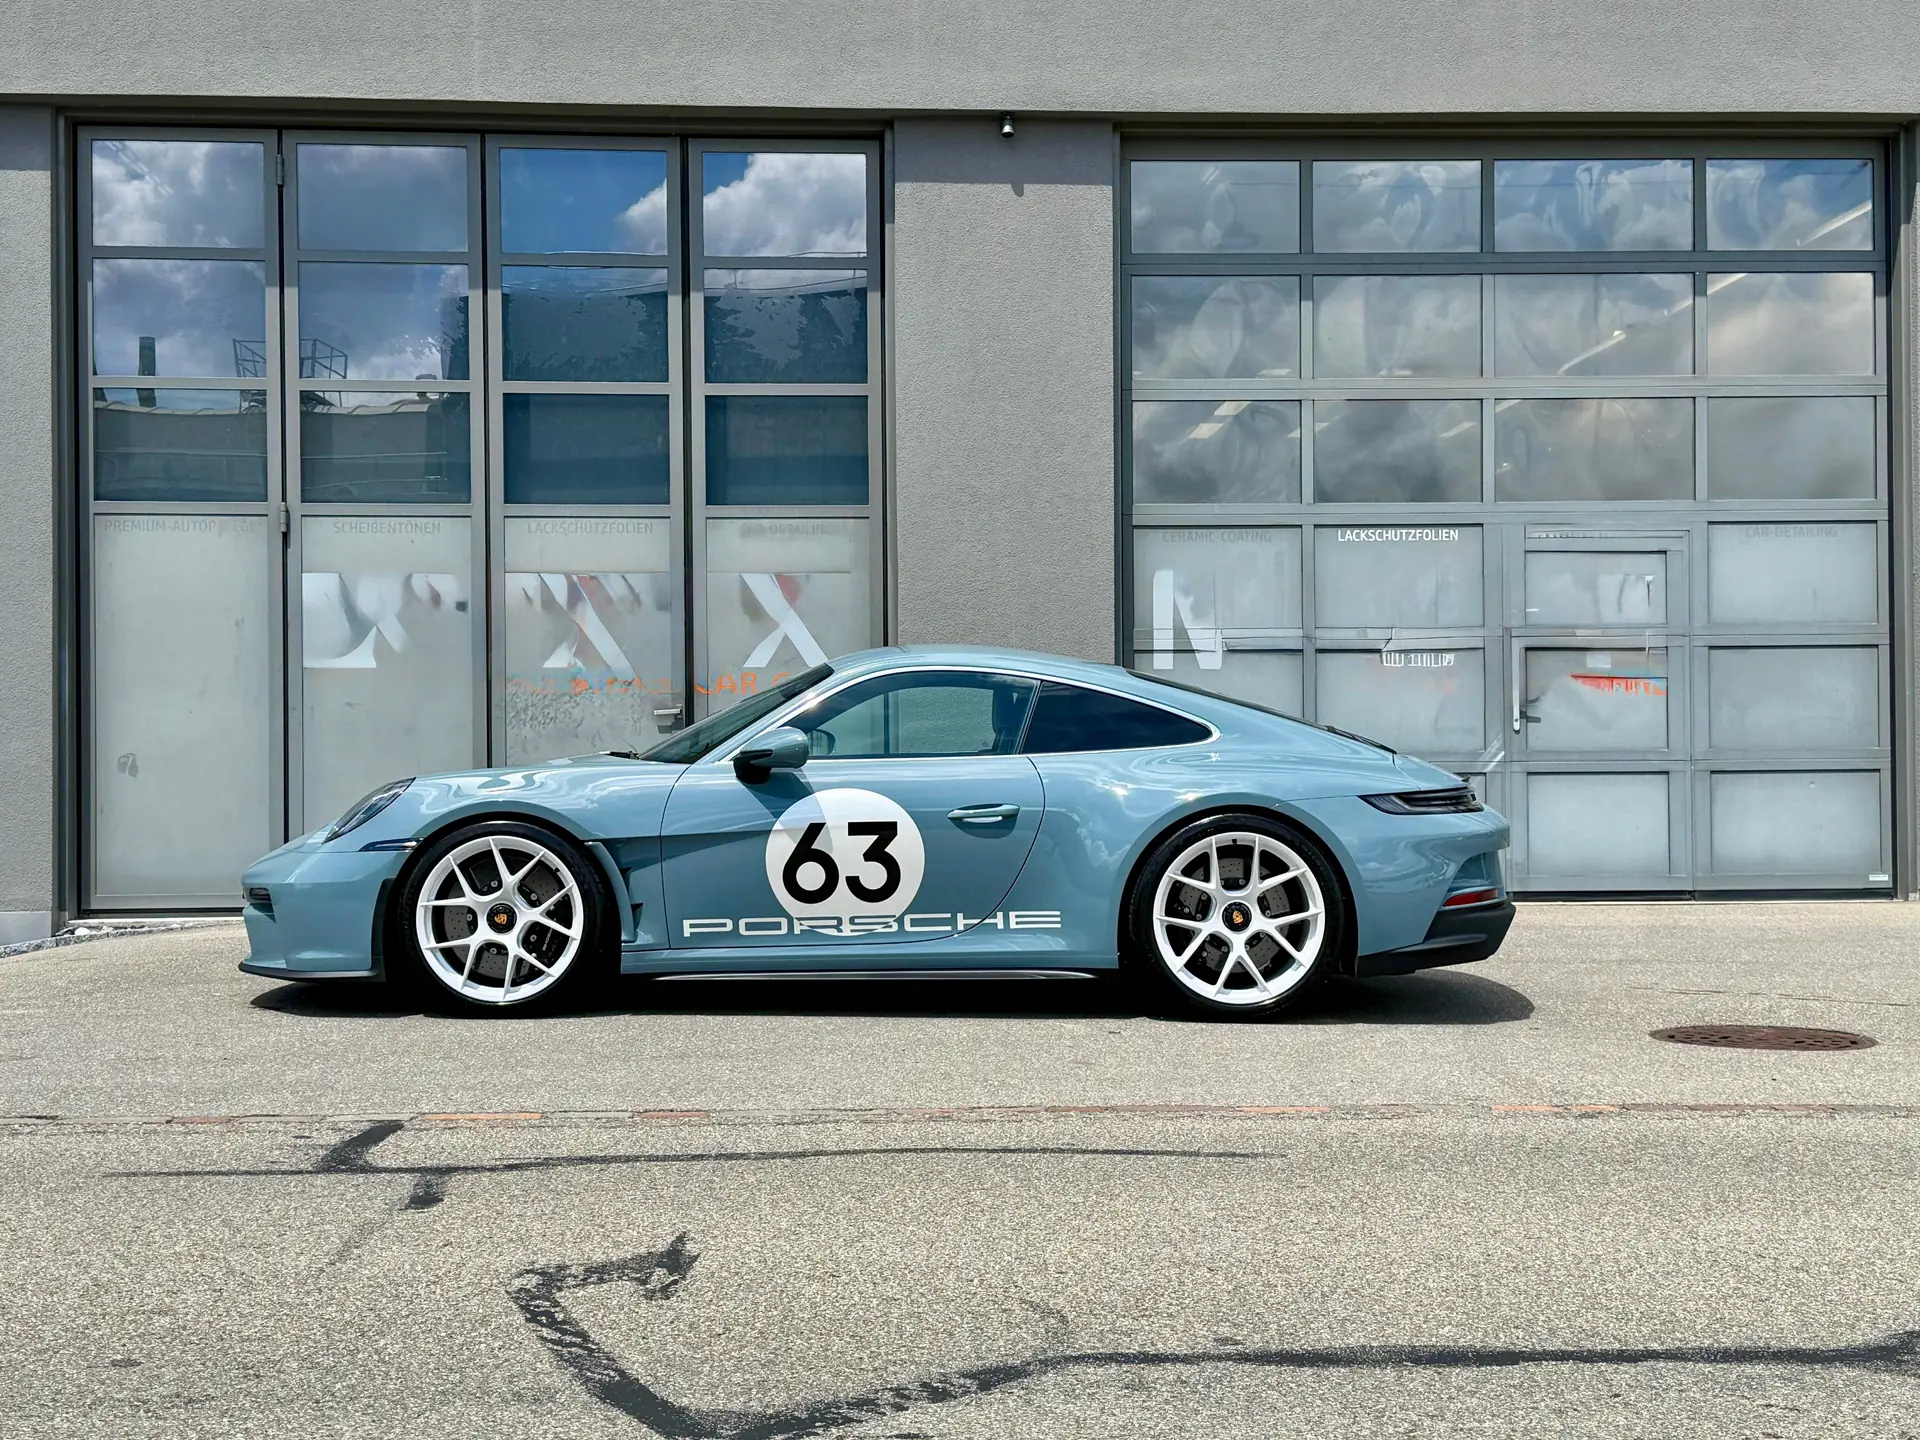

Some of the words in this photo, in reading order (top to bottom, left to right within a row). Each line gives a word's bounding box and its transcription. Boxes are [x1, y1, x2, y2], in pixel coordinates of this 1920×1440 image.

[333, 519, 441, 534] SCHEIBENTÖNEN
[528, 521, 653, 535] LACKSCHUTZFOLIEN
[1745, 526, 1838, 538] CAR-DETAILING
[1162, 530, 1272, 543] CERAMIC-COATING
[1337, 529, 1459, 542] LACKSCHUTZFOLIEN
[782, 821, 901, 904] 63
[683, 910, 1062, 937] PORSCHE
